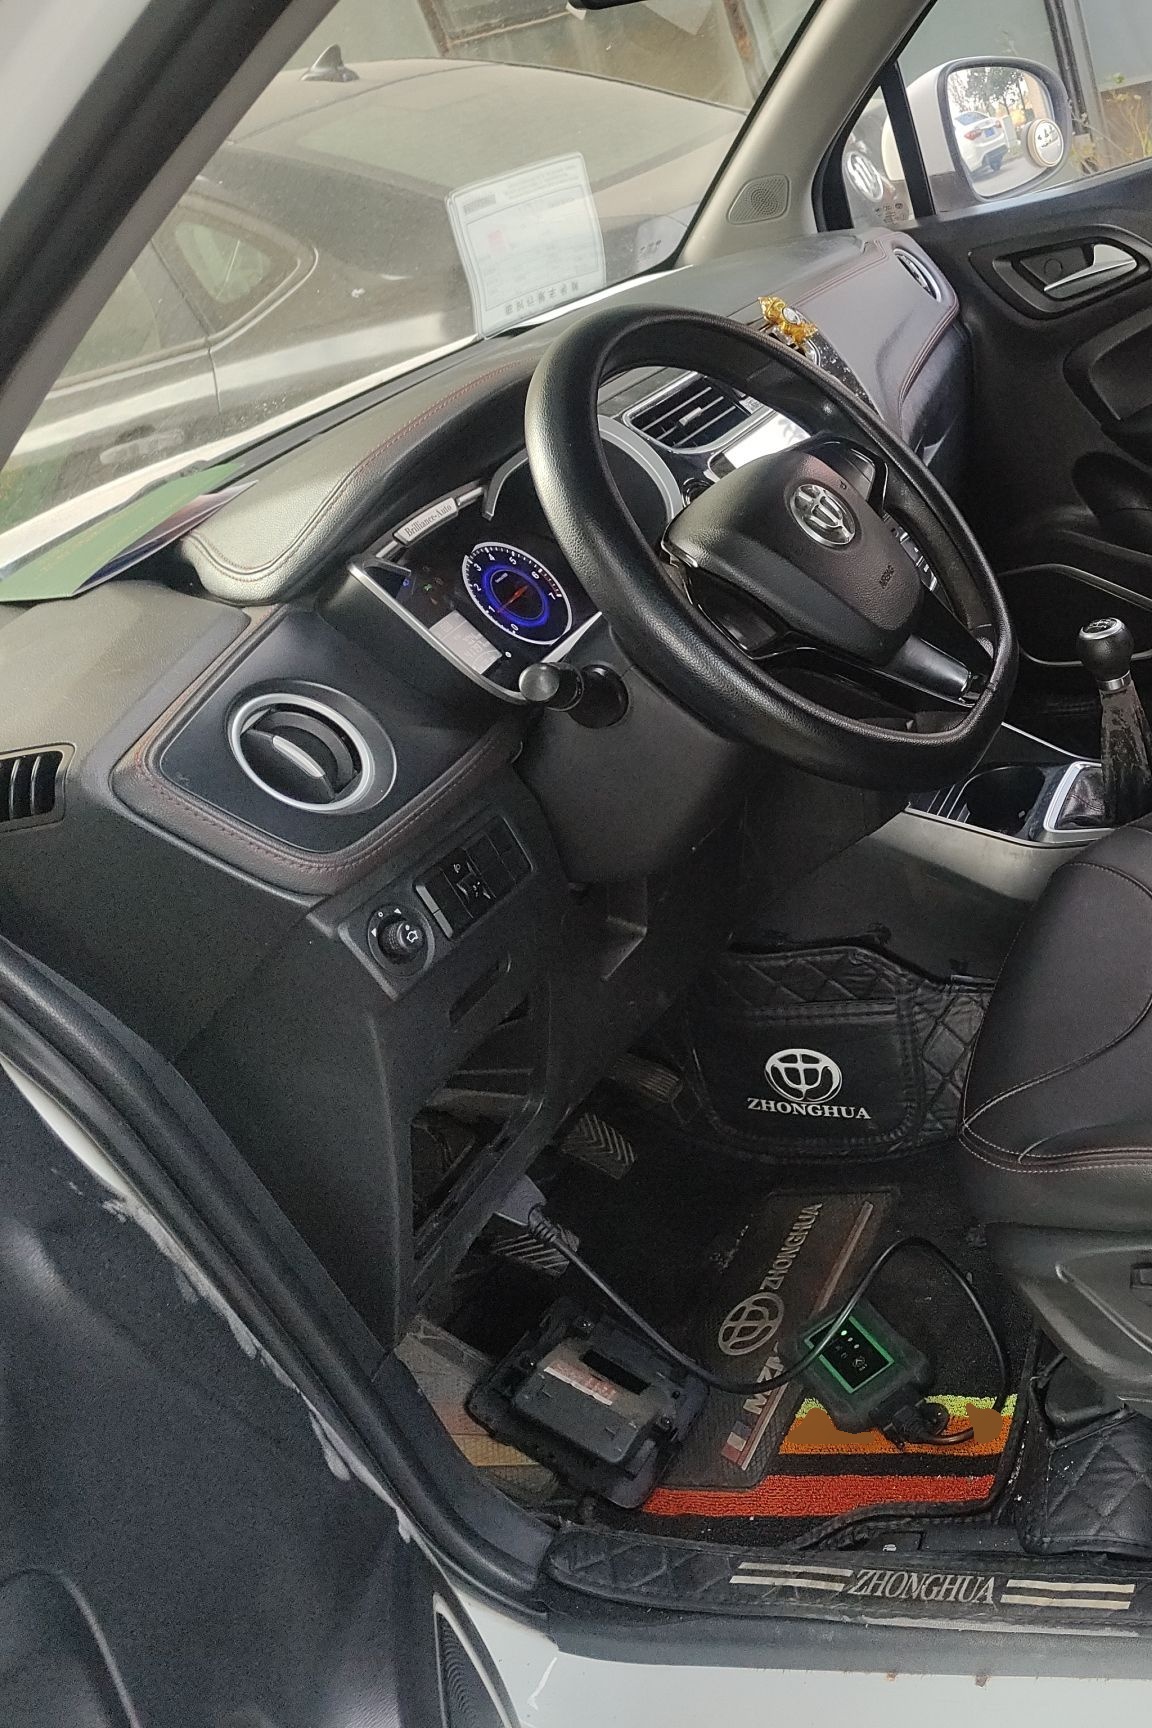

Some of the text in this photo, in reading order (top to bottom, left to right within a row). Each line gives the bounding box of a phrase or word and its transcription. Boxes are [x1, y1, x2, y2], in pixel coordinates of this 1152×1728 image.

[747, 1097, 871, 1119] ZHONGHUA
[760, 1202, 823, 1290] ZHONGHUA
[847, 1568, 995, 1604] ZHONGHUA
